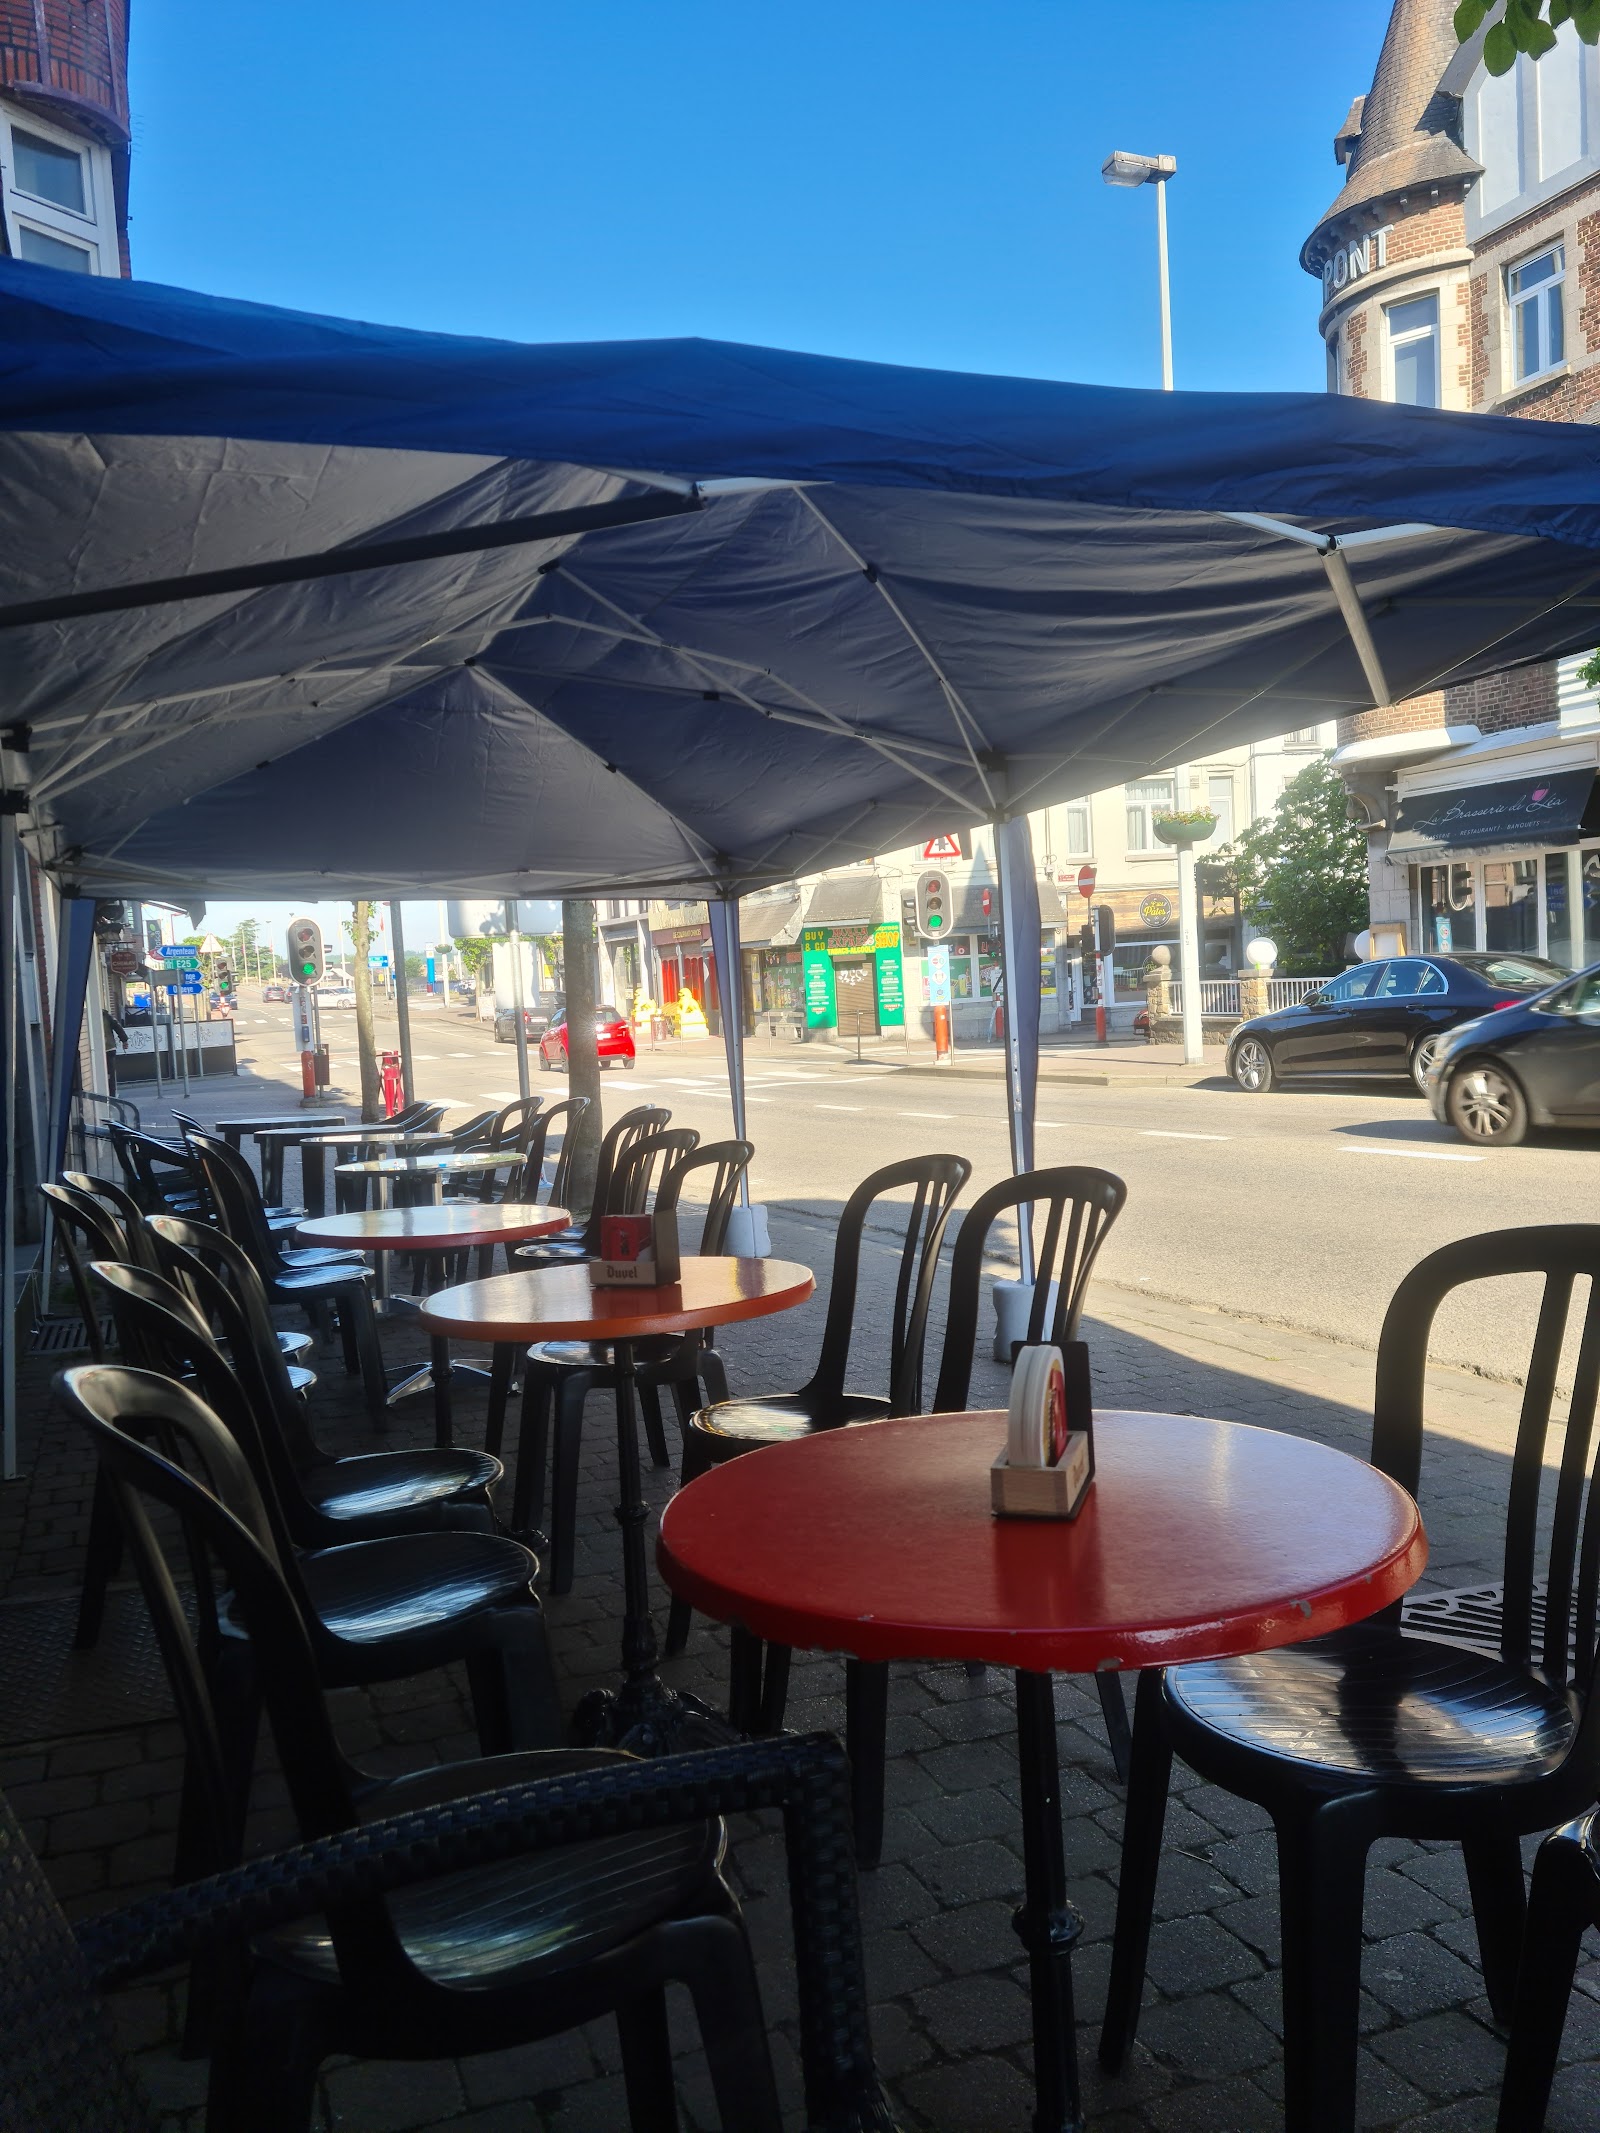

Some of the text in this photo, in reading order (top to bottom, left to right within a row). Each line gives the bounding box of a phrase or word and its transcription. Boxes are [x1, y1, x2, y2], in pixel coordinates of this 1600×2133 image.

[1323, 224, 1394, 302] PONT
[1413, 792, 1567, 831] La Brasserie de Léa
[1507, 820, 1541, 830] BANQUETS
[805, 931, 824, 941] BUY
[166, 947, 195, 956] Argenteau
[814, 942, 826, 951] GO
[176, 960, 192, 968] E25
[173, 985, 194, 994] Opeye
[606, 1264, 638, 1279] Duvel
